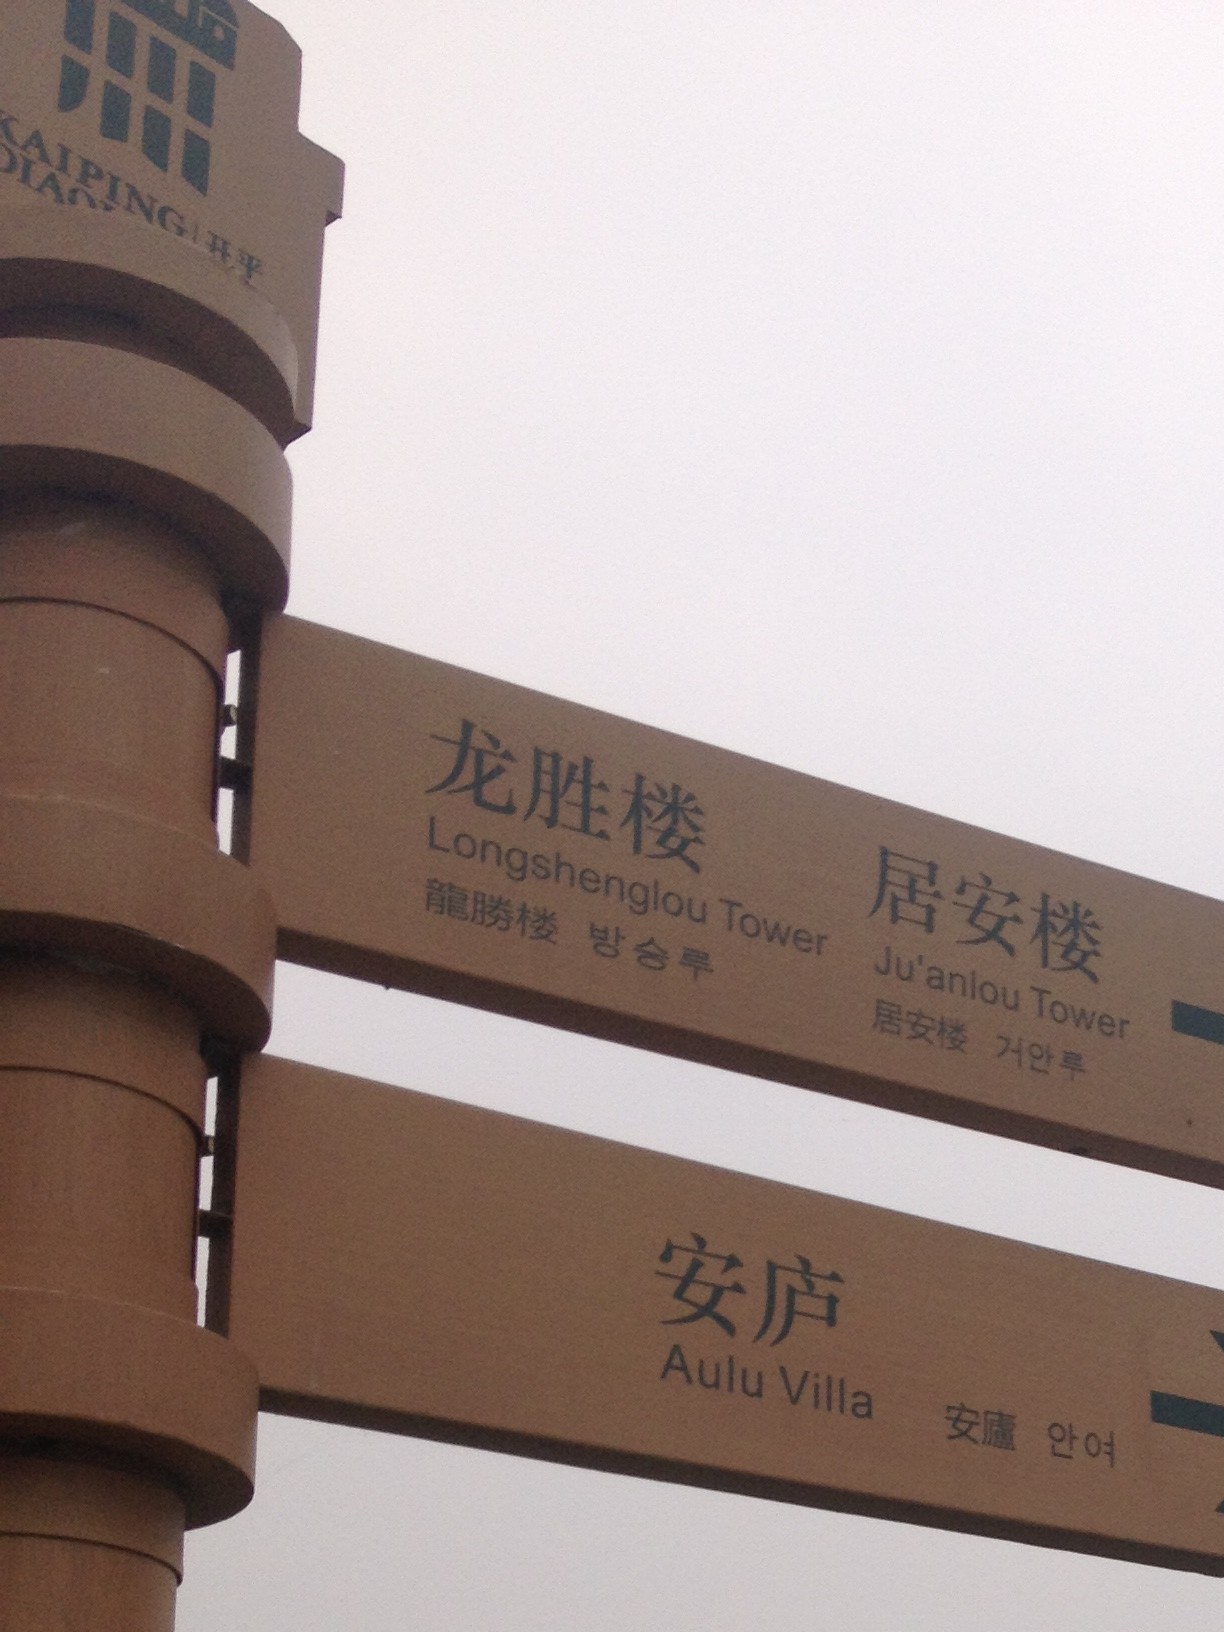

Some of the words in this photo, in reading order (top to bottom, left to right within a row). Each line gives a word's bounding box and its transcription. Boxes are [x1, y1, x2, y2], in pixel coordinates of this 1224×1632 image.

[425, 719, 706, 873] 龙胜楼
[427, 816, 708, 924] Longshenglou
[719, 899, 829, 957] Tower
[867, 845, 1102, 985] 居安楼
[872, 998, 969, 1055] 居安楼
[874, 946, 1021, 1012] Ju'anlou
[1029, 985, 1131, 1039] Tower
[654, 1232, 845, 1347] 安庐
[660, 1344, 765, 1399] Aulu
[779, 1365, 874, 1420] Villa
